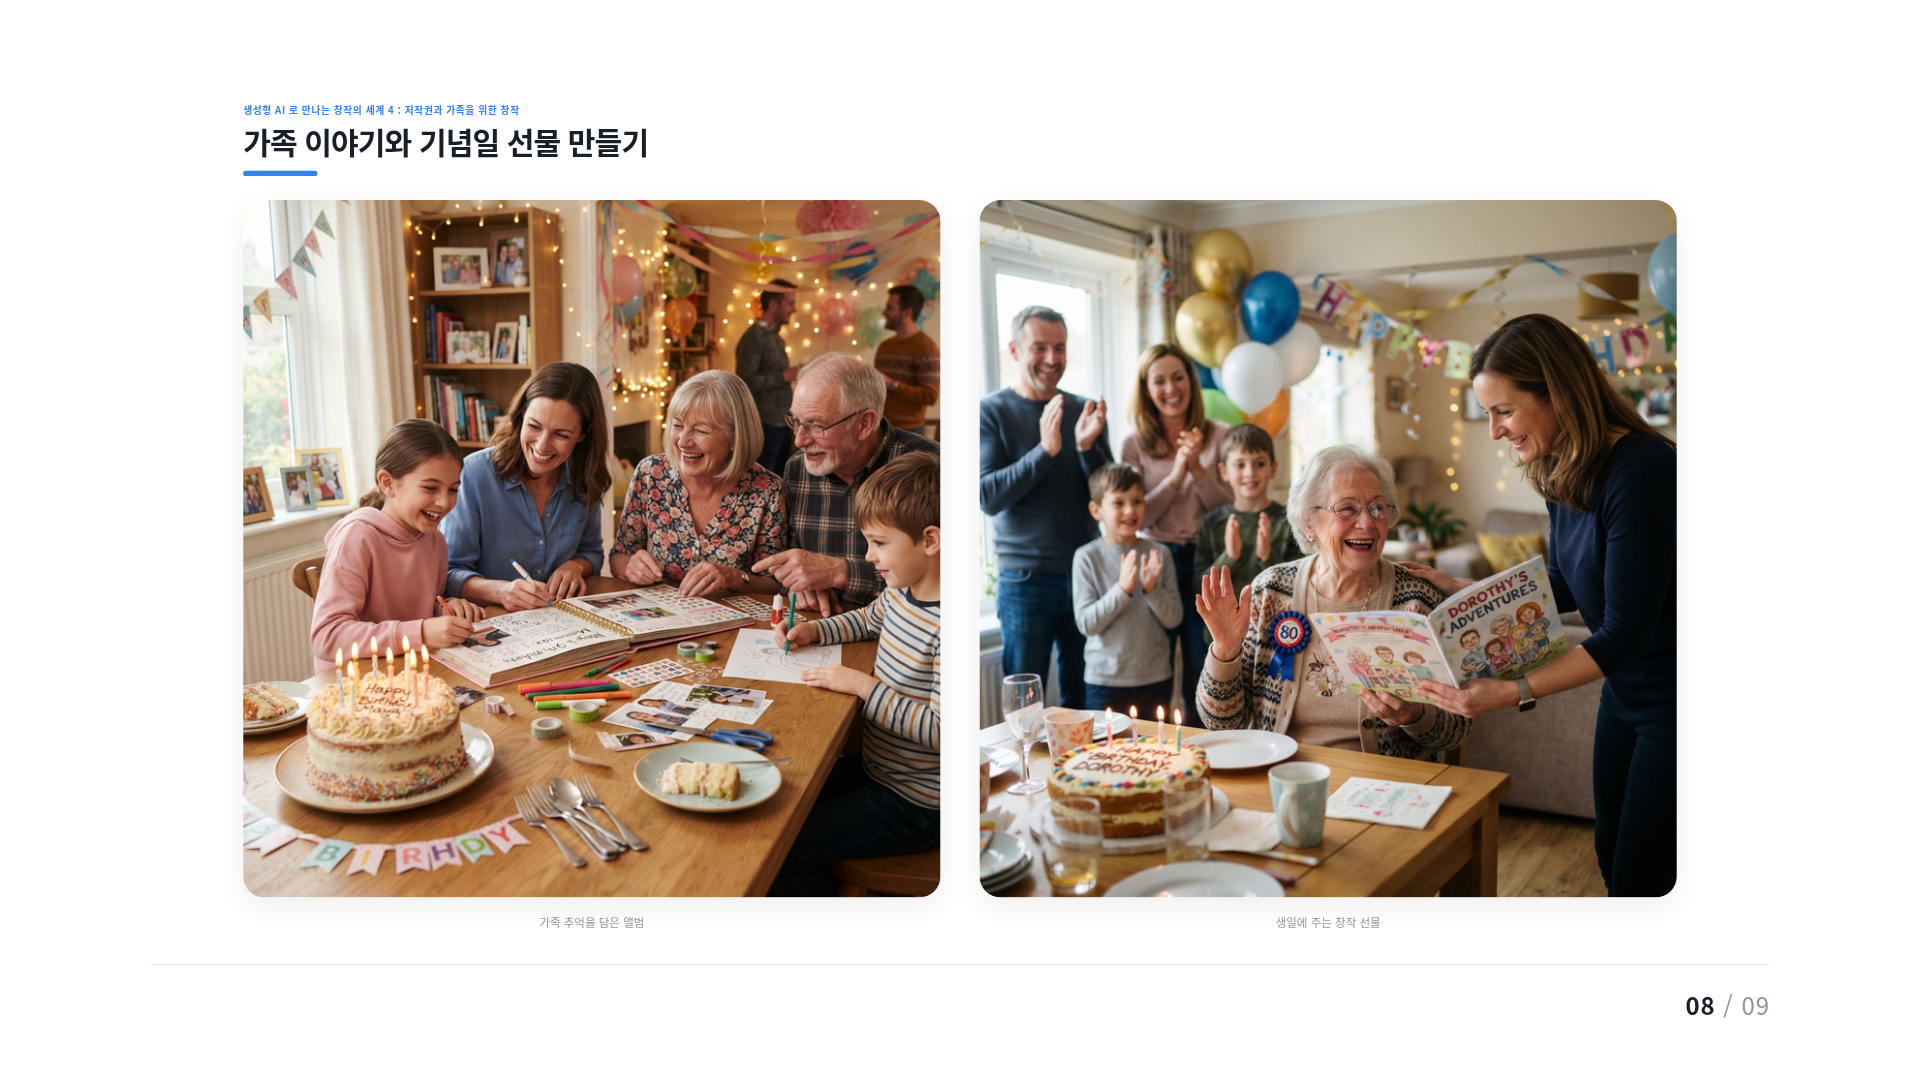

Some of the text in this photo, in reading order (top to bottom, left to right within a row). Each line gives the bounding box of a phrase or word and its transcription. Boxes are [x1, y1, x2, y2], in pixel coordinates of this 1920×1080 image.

[1315, 280, 1445, 370] HAPPY
[1447, 570, 1529, 619] DOROTHY'S
[1450, 580, 1538, 634] ADVENTURES
[1280, 625, 1299, 640] 80
[364, 682, 412, 703] Happy
[1116, 746, 1180, 759] HAPPY
[1071, 761, 1160, 778] DOROTHY
[314, 826, 513, 867] BIRHDY
